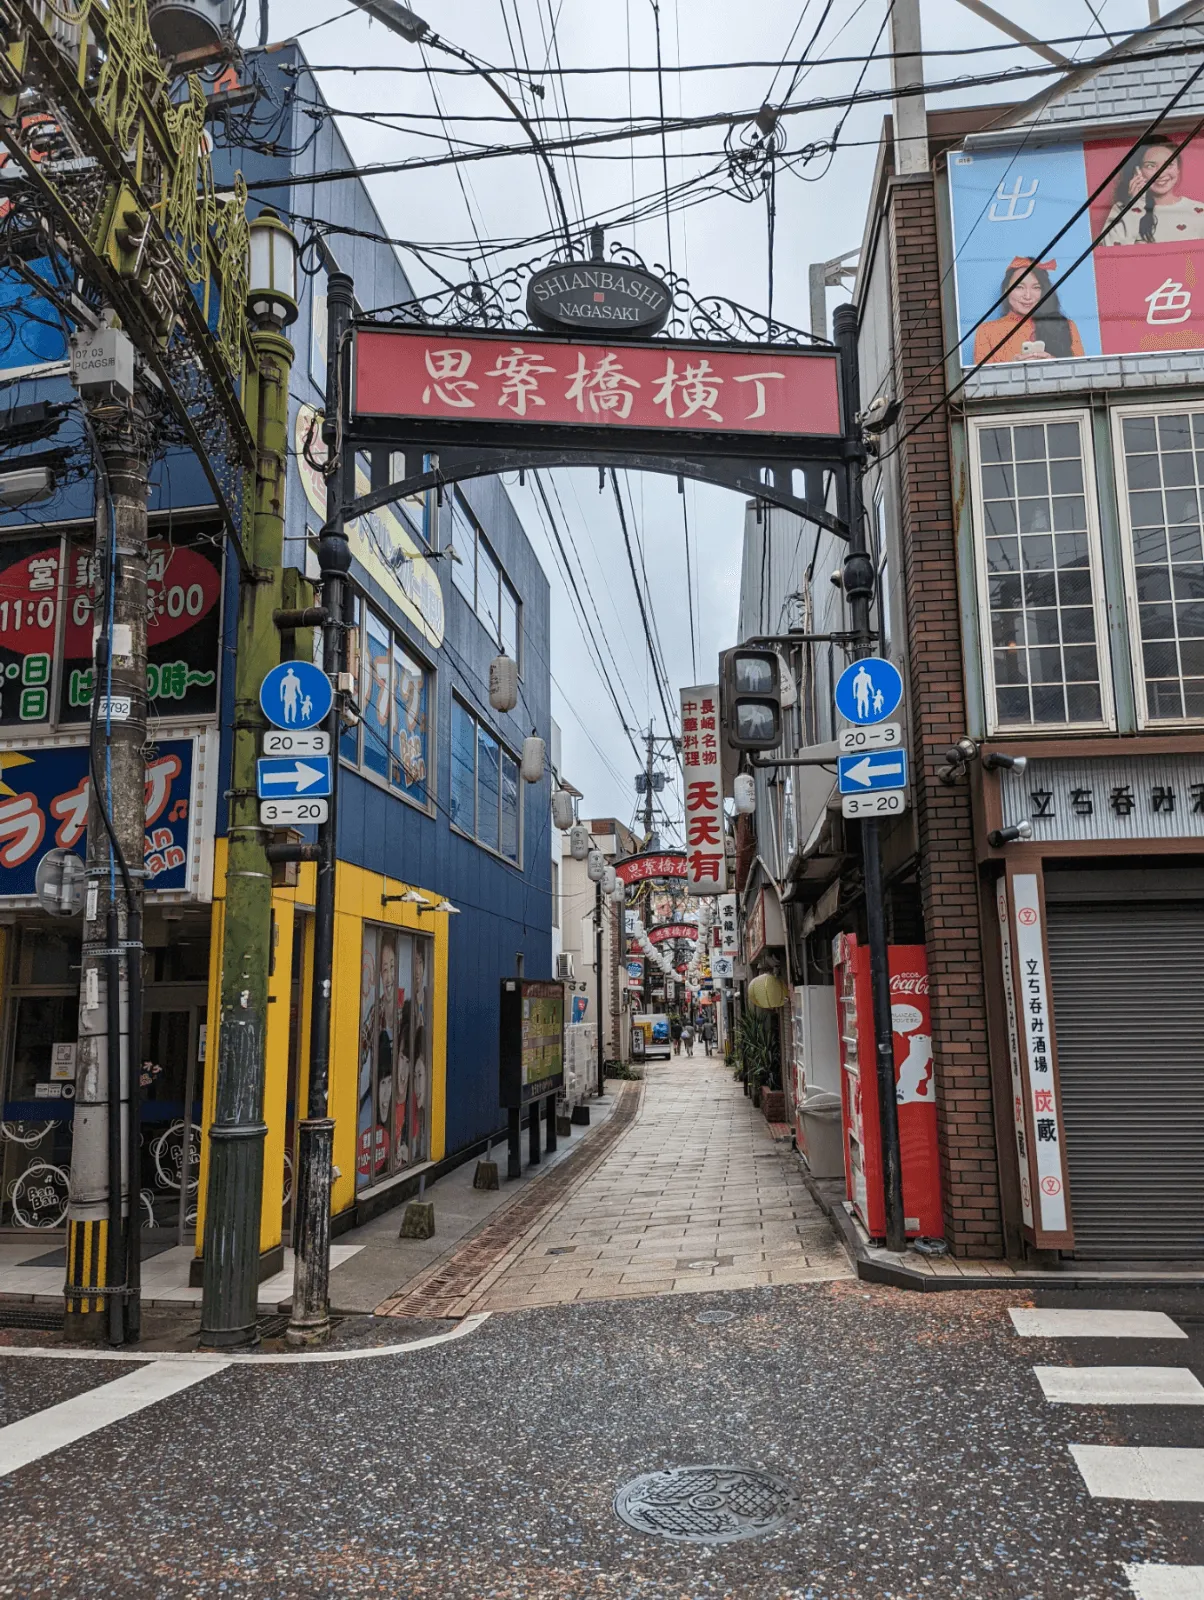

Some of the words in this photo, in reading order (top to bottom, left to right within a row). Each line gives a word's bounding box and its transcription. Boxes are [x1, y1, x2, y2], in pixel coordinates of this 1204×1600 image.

[987, 175, 1040, 223] 出
[533, 272, 666, 312] SHIANBASHI
[558, 301, 640, 322] NAGASAKI
[1144, 277, 1193, 325] 色
[422, 347, 786, 422] 思案橋横丁
[682, 701, 700, 766] 中華料理
[700, 698, 717, 765] 長崎名物
[686, 780, 724, 883] 天天有
[1025, 957, 1048, 1074] 立ち呑み酒場
[28, 1185, 55, 1200] Ban
[32, 1194, 59, 1210] Ban
